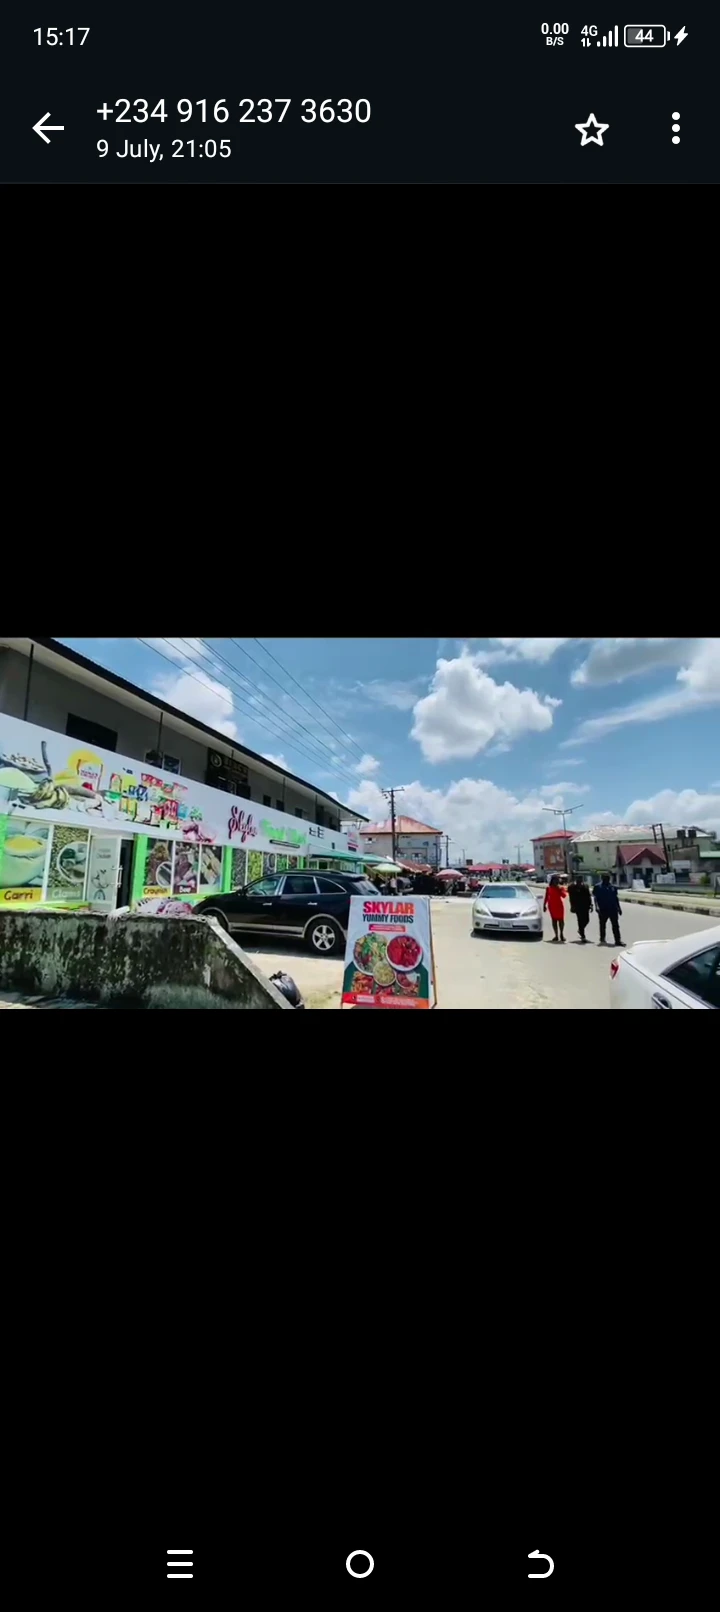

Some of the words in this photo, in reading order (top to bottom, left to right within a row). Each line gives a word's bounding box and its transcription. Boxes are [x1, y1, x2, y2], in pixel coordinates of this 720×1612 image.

[4, 890, 33, 901] Garri
[363, 901, 415, 914] SKYLAR
[362, 914, 389, 923] YUMMY
[389, 914, 414, 924] FOODS
